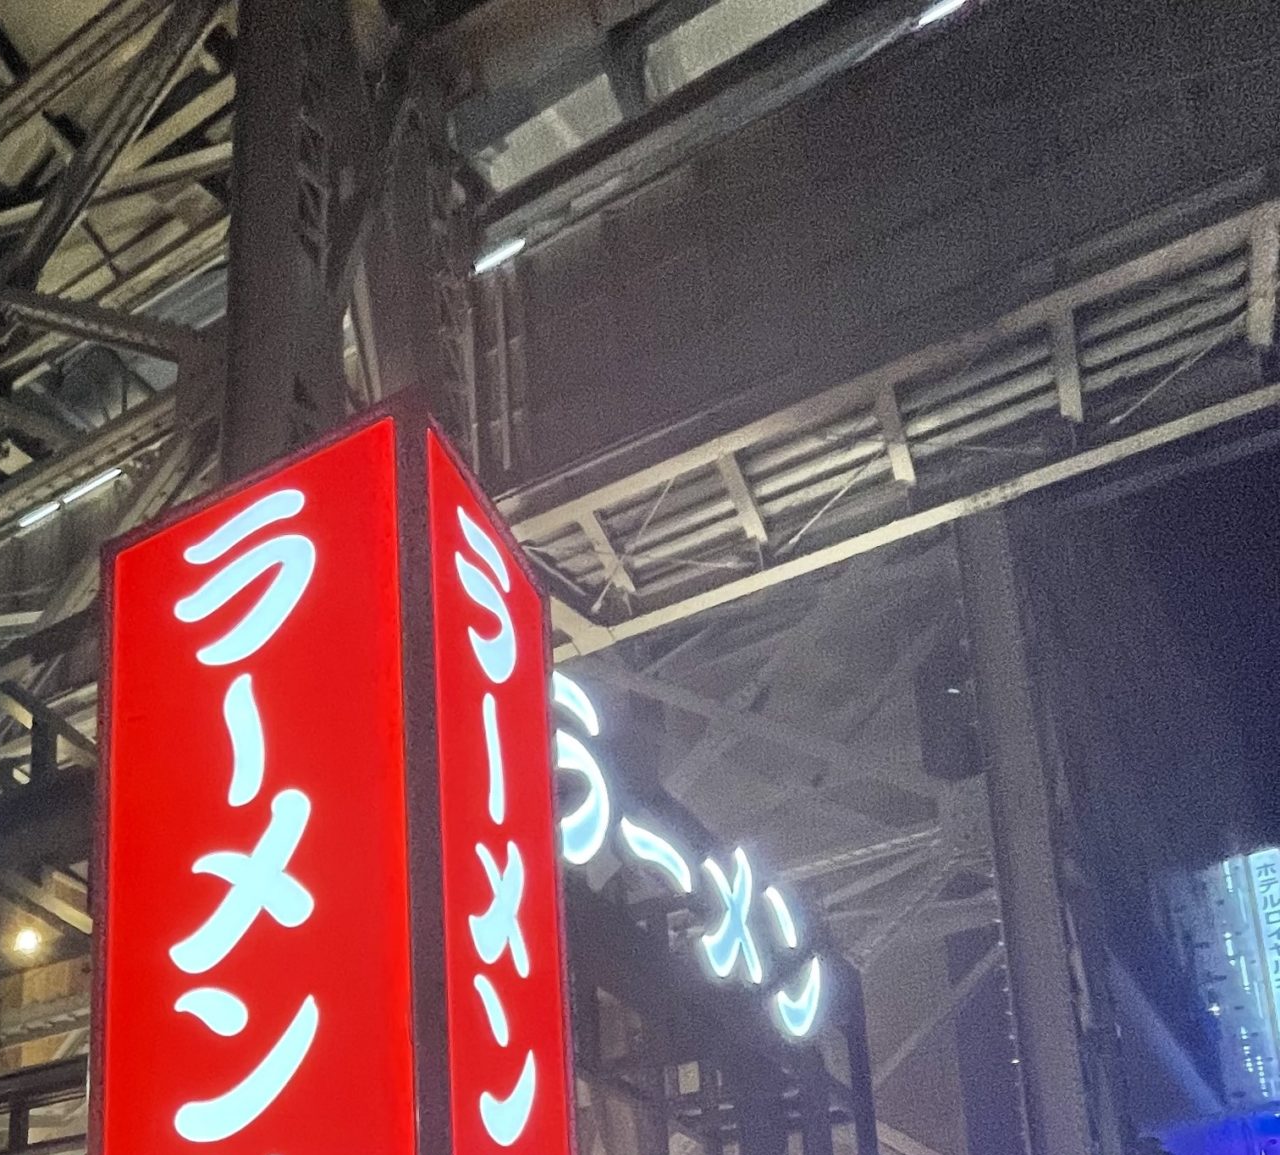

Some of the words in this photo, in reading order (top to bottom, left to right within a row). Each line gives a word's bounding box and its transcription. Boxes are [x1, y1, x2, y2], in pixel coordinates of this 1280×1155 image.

[1256, 863, 1280, 989] ホテルロイヤ
